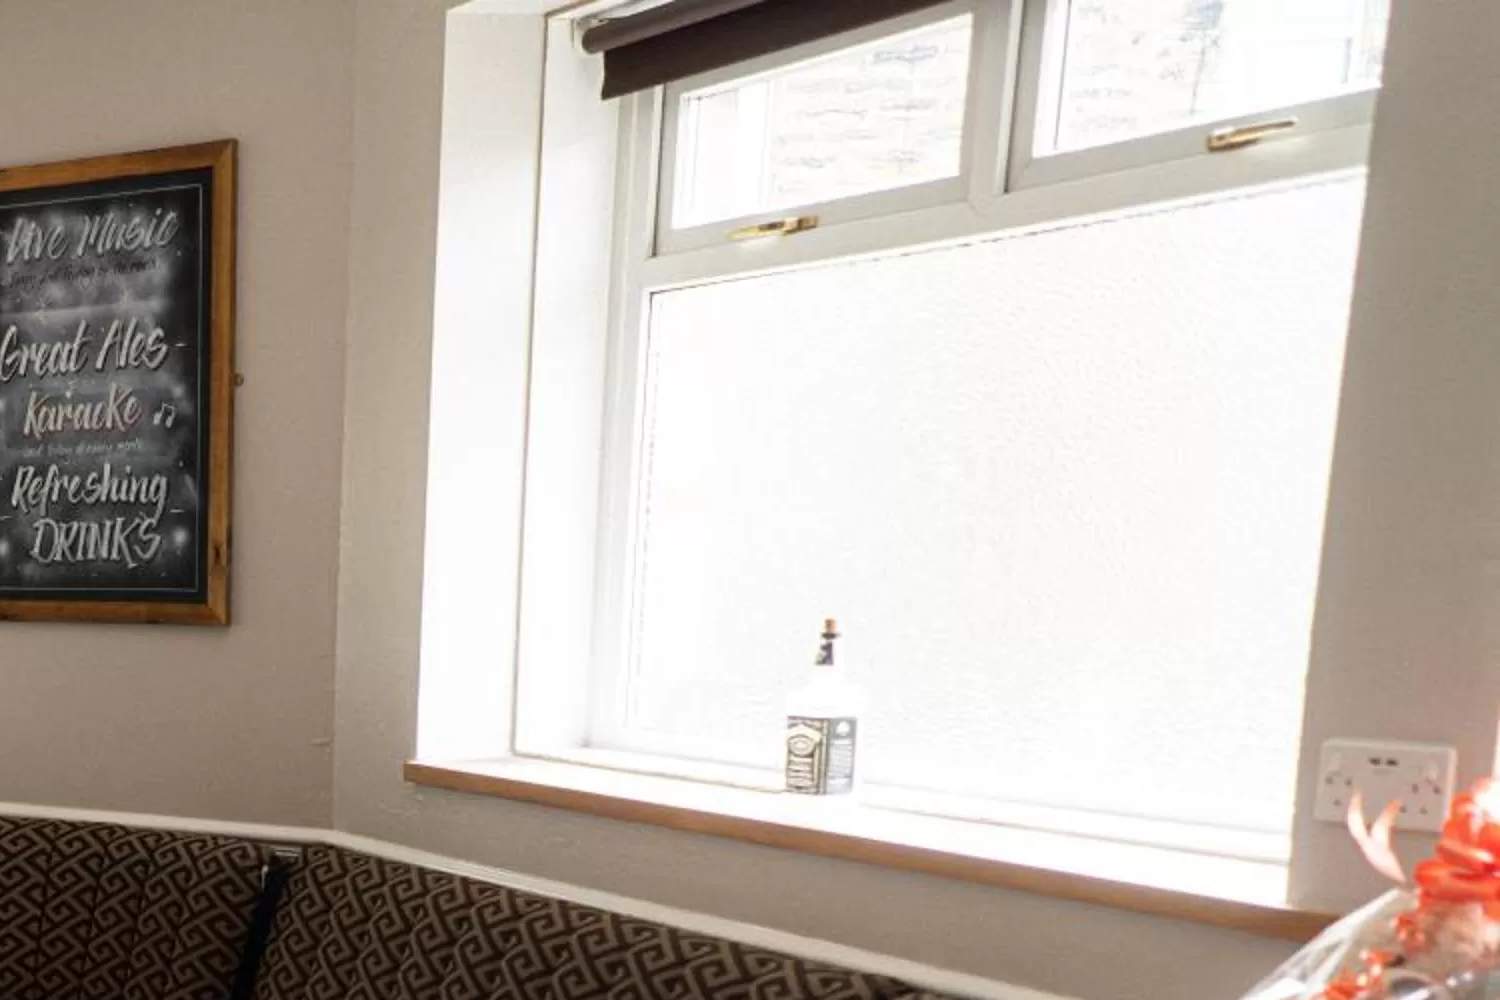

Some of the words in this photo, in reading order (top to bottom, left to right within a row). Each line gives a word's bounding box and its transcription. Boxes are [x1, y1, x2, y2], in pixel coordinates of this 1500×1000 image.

[6, 217, 68, 263] Live
[75, 208, 181, 255] Music
[95, 317, 169, 370] Ales
[11, 463, 168, 527] Refreshing
[30, 514, 161, 569] DRINKS
